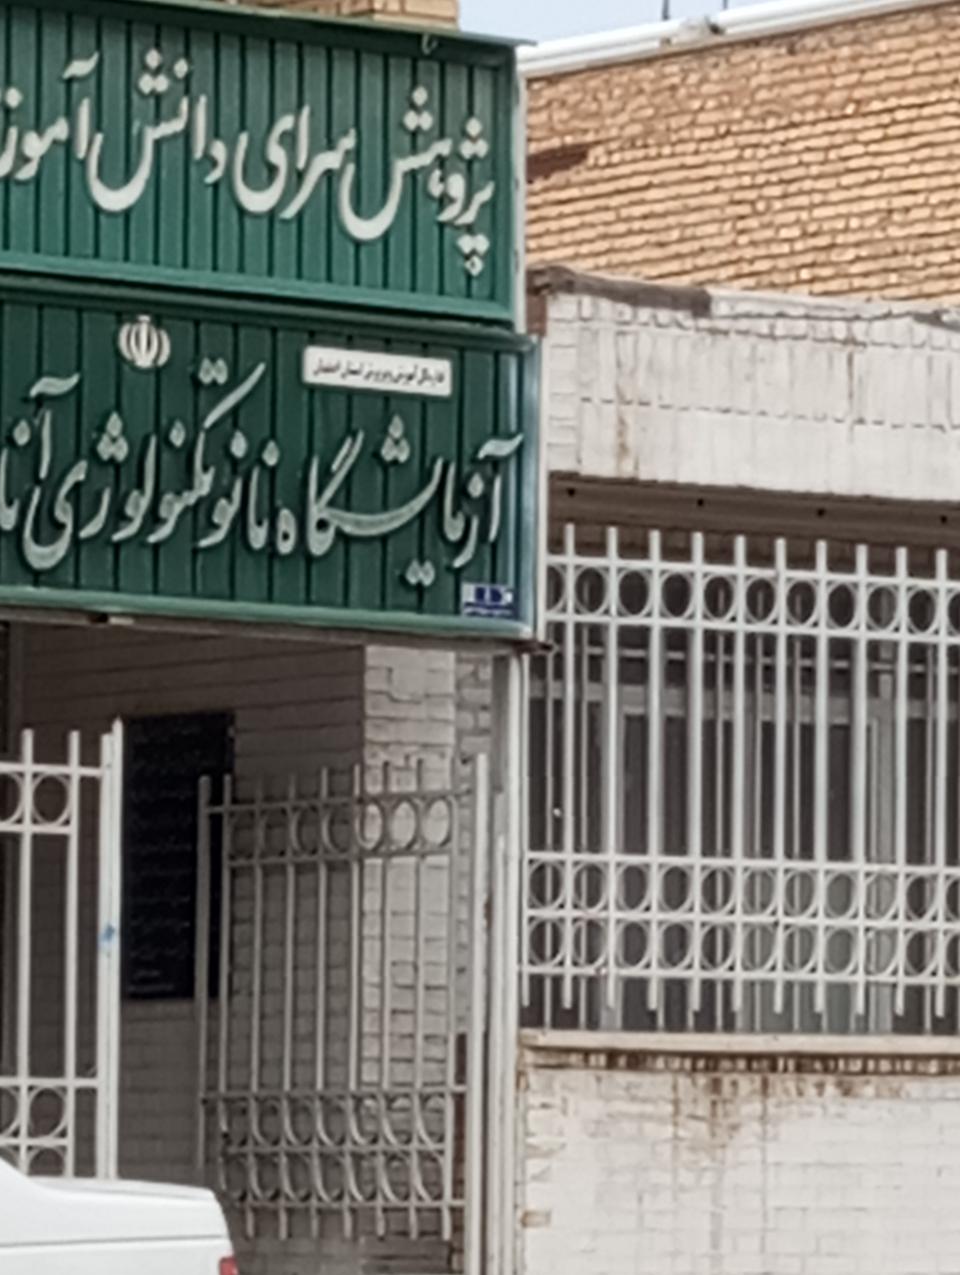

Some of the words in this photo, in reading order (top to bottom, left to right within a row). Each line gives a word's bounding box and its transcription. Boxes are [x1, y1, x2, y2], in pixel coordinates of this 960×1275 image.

[87, 48, 227, 213] دانش
[234, 105, 356, 220] سرای
[341, 86, 494, 276] پژوهش
[276, 413, 523, 588] آزمایشگاه
